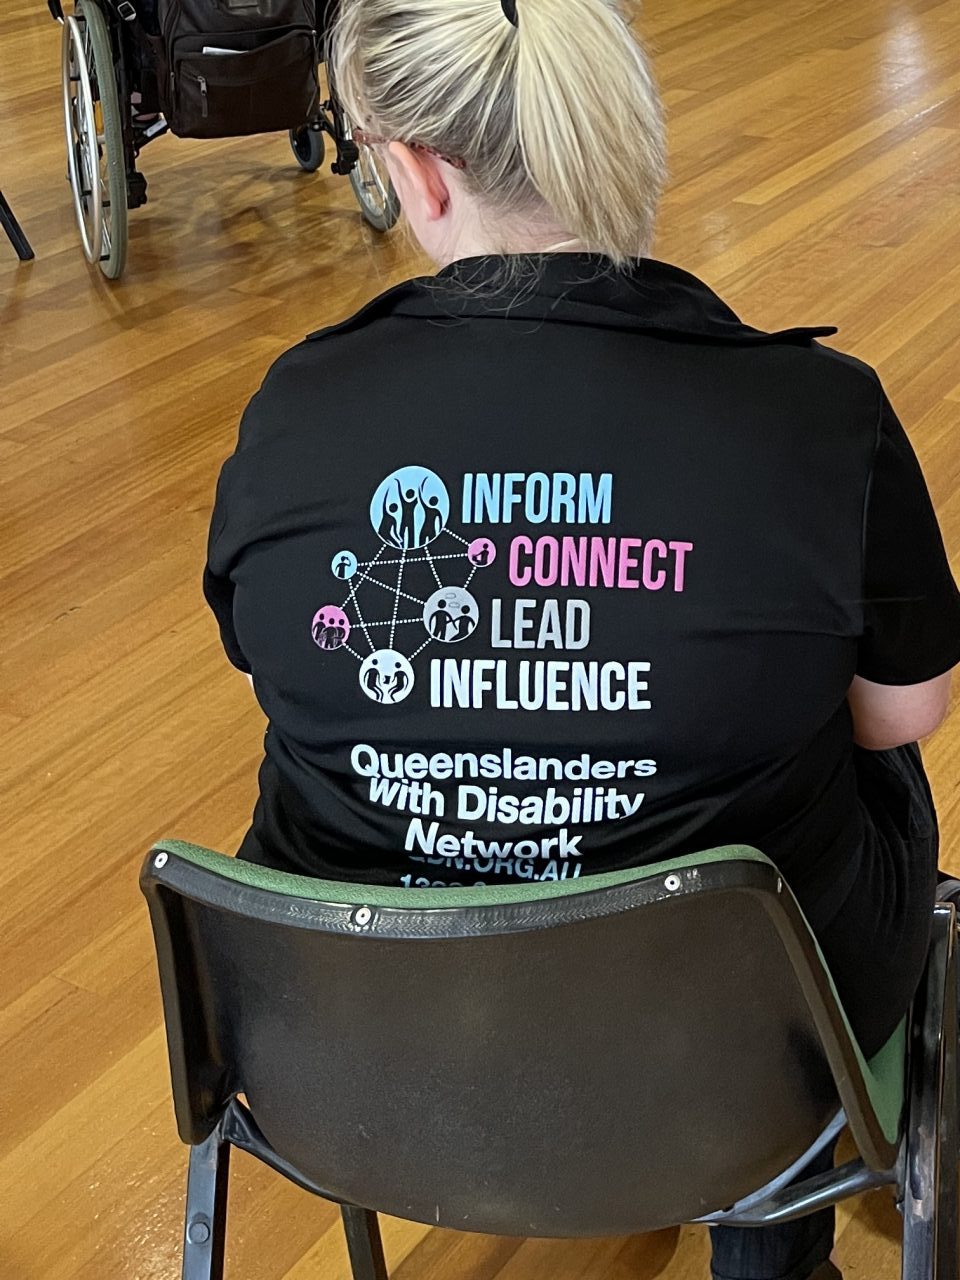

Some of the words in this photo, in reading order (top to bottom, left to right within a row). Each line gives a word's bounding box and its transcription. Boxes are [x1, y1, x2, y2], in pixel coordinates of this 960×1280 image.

[462, 472, 613, 524] INFORM
[509, 536, 693, 592] CONNECT
[490, 599, 592, 649] LEAD
[430, 659, 652, 711] INFLUENCE
[350, 743, 657, 781] Queenslanders
[368, 777, 445, 817] with
[457, 785, 645, 826] Disability
[404, 818, 583, 859] Network
[409, 856, 582, 881] N.ORG.AU
